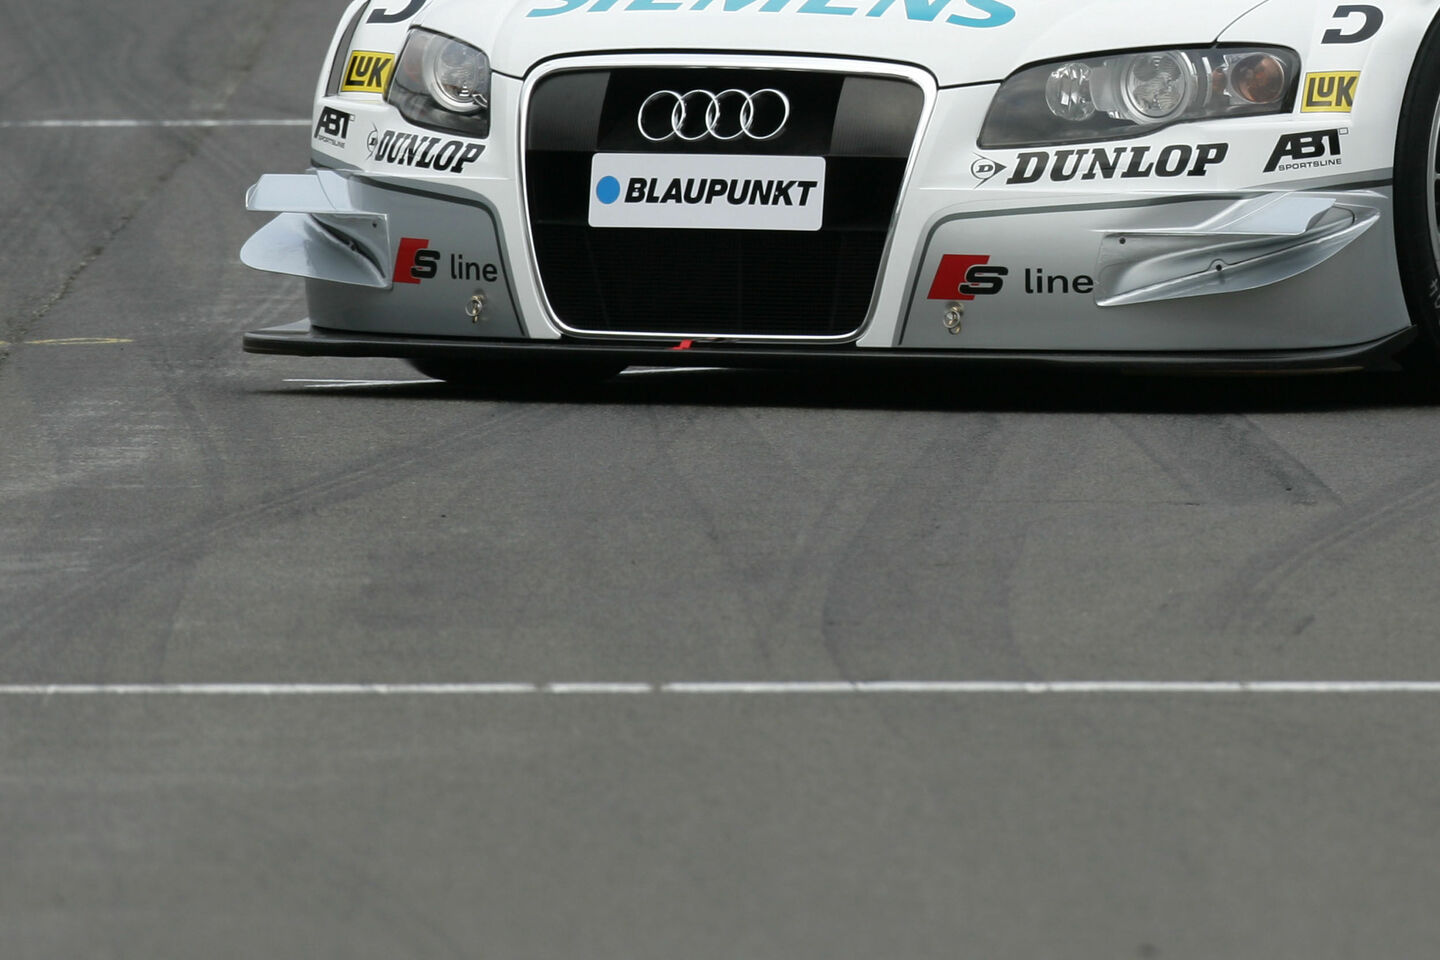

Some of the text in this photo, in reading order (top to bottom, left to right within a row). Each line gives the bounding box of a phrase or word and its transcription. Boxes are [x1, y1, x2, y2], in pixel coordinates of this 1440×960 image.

[314, 106, 350, 139] ABT
[375, 130, 486, 173] DUNLOP
[1006, 142, 1229, 184] DUNLOP
[1263, 128, 1341, 173] ABT
[1278, 158, 1342, 172] SPORTSLINE
[624, 176, 817, 207] BLAUPUNKT
[410, 249, 498, 282] S line
[959, 266, 1094, 295] S line
